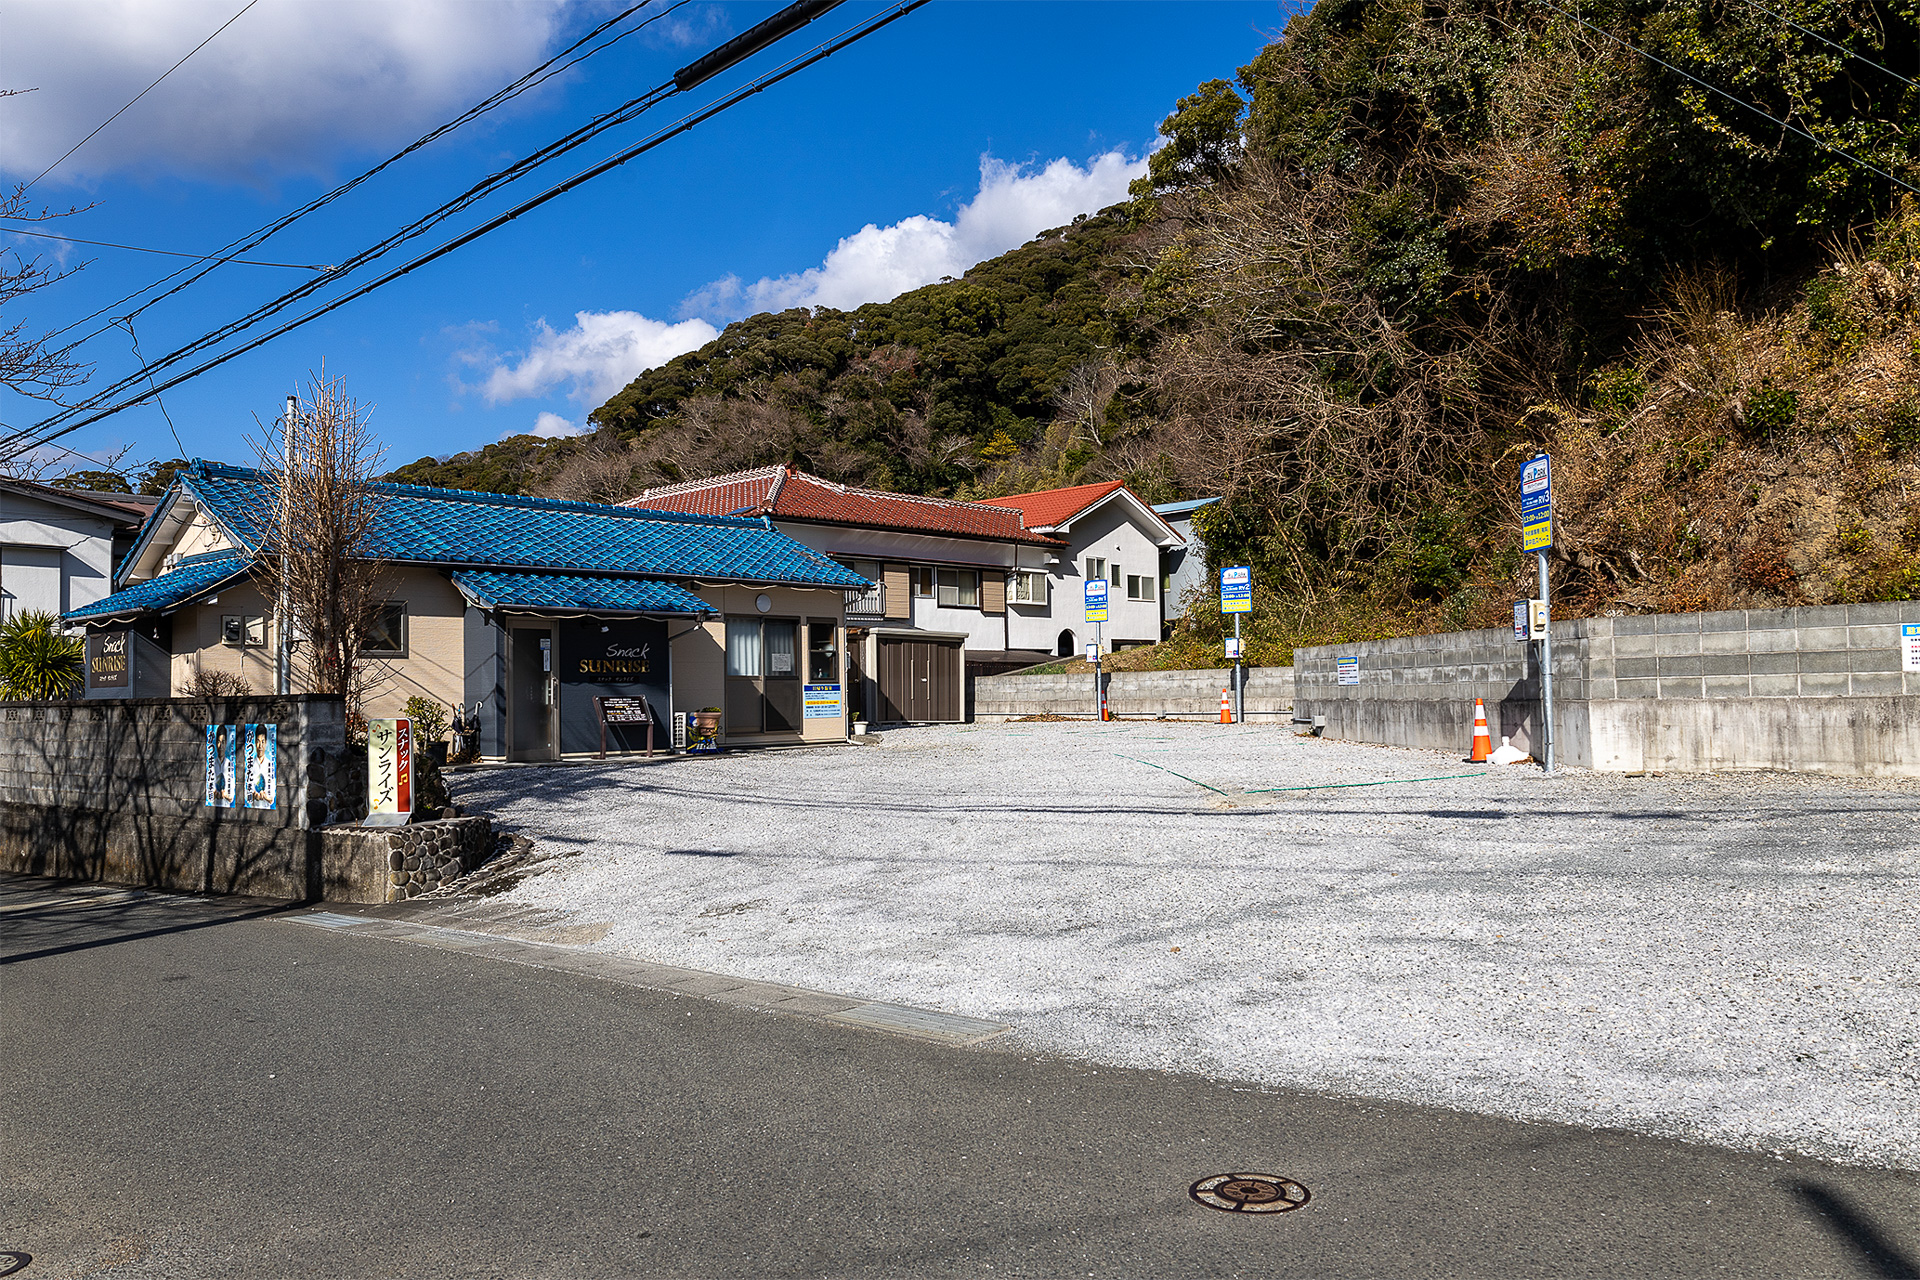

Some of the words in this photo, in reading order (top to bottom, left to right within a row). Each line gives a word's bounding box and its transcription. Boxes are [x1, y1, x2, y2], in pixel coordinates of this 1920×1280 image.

[103, 632, 126, 655] Snack
[605, 642, 650, 660] Snack
[91, 655, 126, 673] SUNRISE
[579, 659, 651, 673] SUNRISE
[397, 728, 409, 772] スナック
[377, 729, 394, 806] サンライズ
